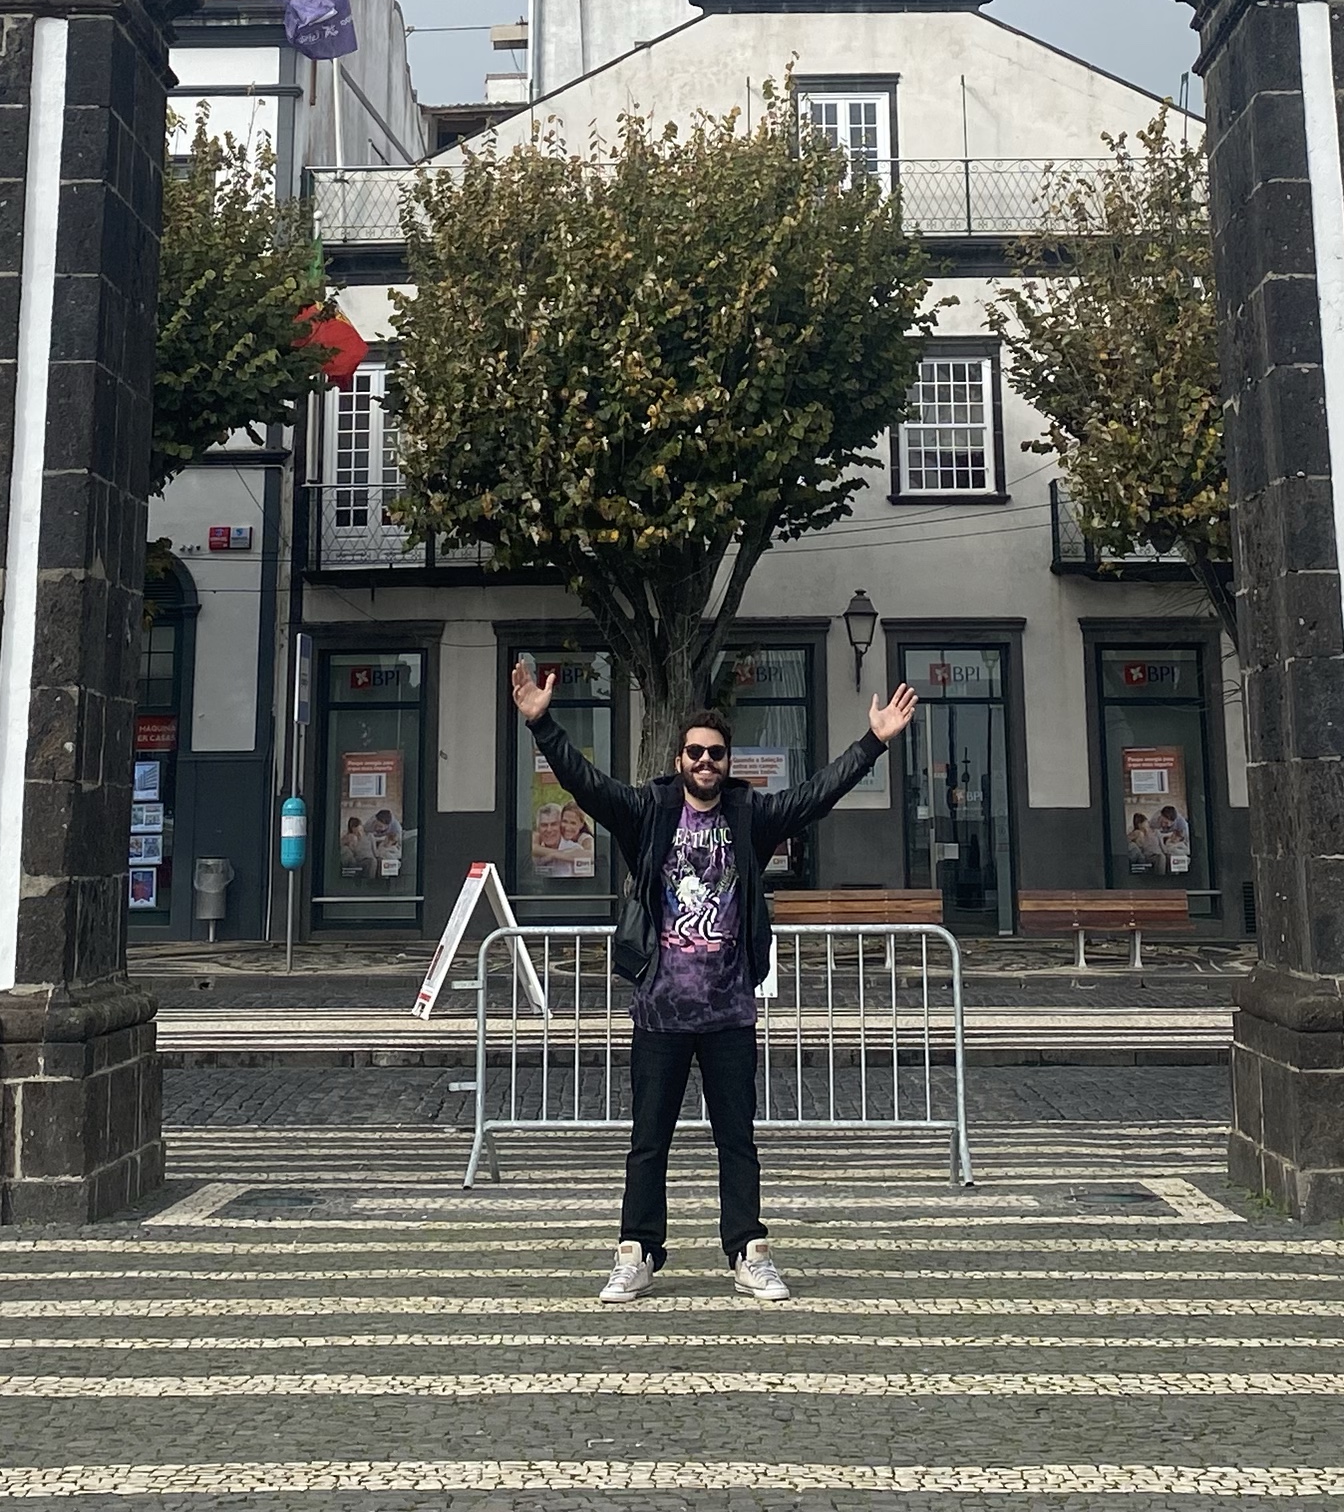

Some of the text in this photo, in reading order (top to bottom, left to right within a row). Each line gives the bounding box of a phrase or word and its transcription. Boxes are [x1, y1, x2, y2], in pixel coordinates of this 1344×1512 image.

[372, 670, 400, 687] BPI
[756, 667, 783, 682] BPI
[953, 666, 980, 682] BPI
[1148, 666, 1175, 683] BPI
[966, 791, 983, 802] BPI
